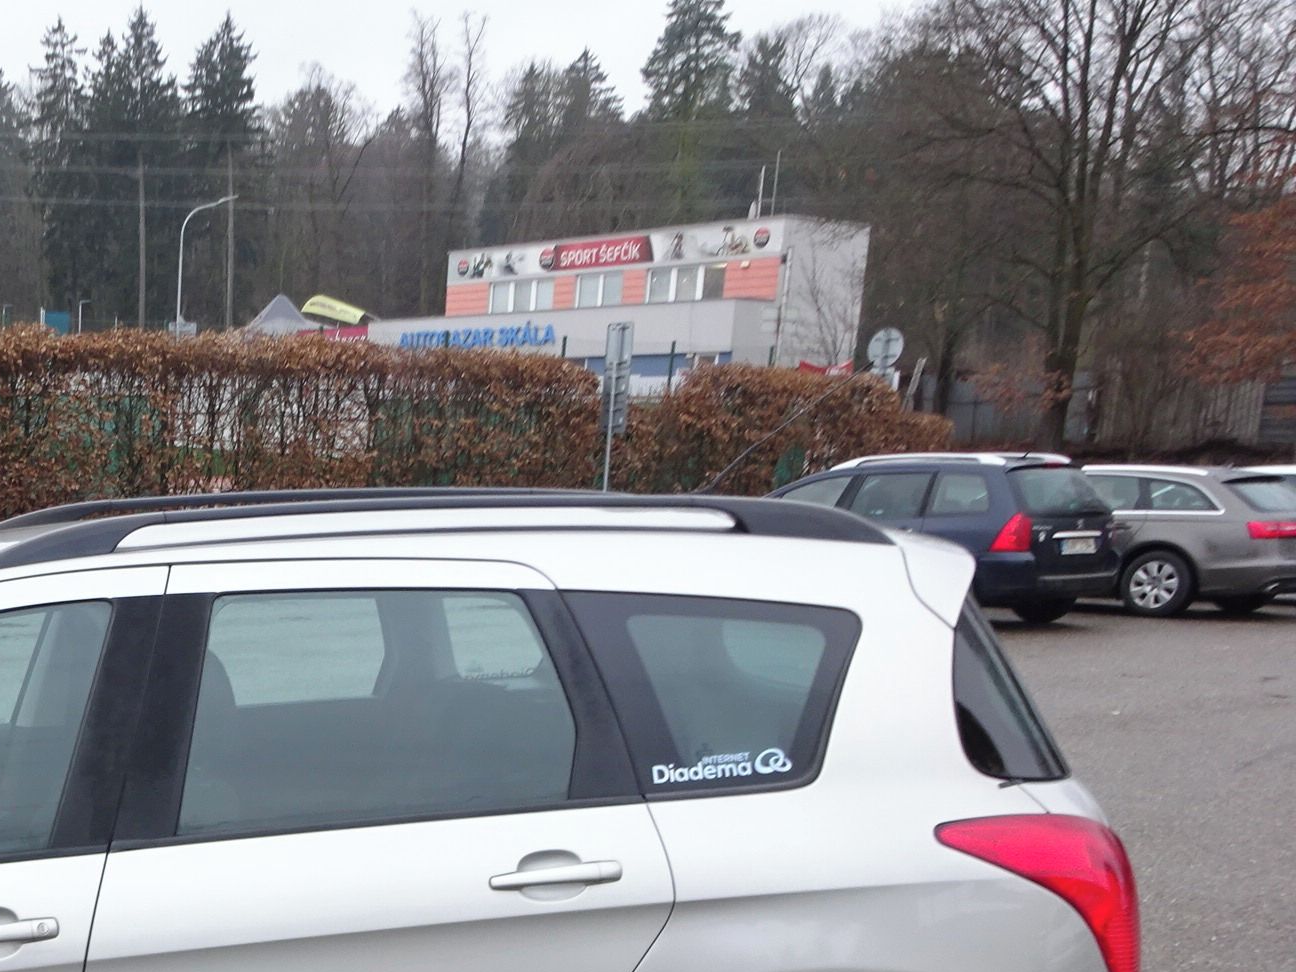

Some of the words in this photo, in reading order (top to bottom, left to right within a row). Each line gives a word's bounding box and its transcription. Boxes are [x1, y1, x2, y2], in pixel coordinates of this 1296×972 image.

[560, 247, 599, 267] SPORT
[598, 241, 641, 263] ŠEFČÍK
[498, 321, 556, 346] SKÁLA
[700, 752, 750, 765] INTERNET
[651, 760, 753, 784] Diadema
